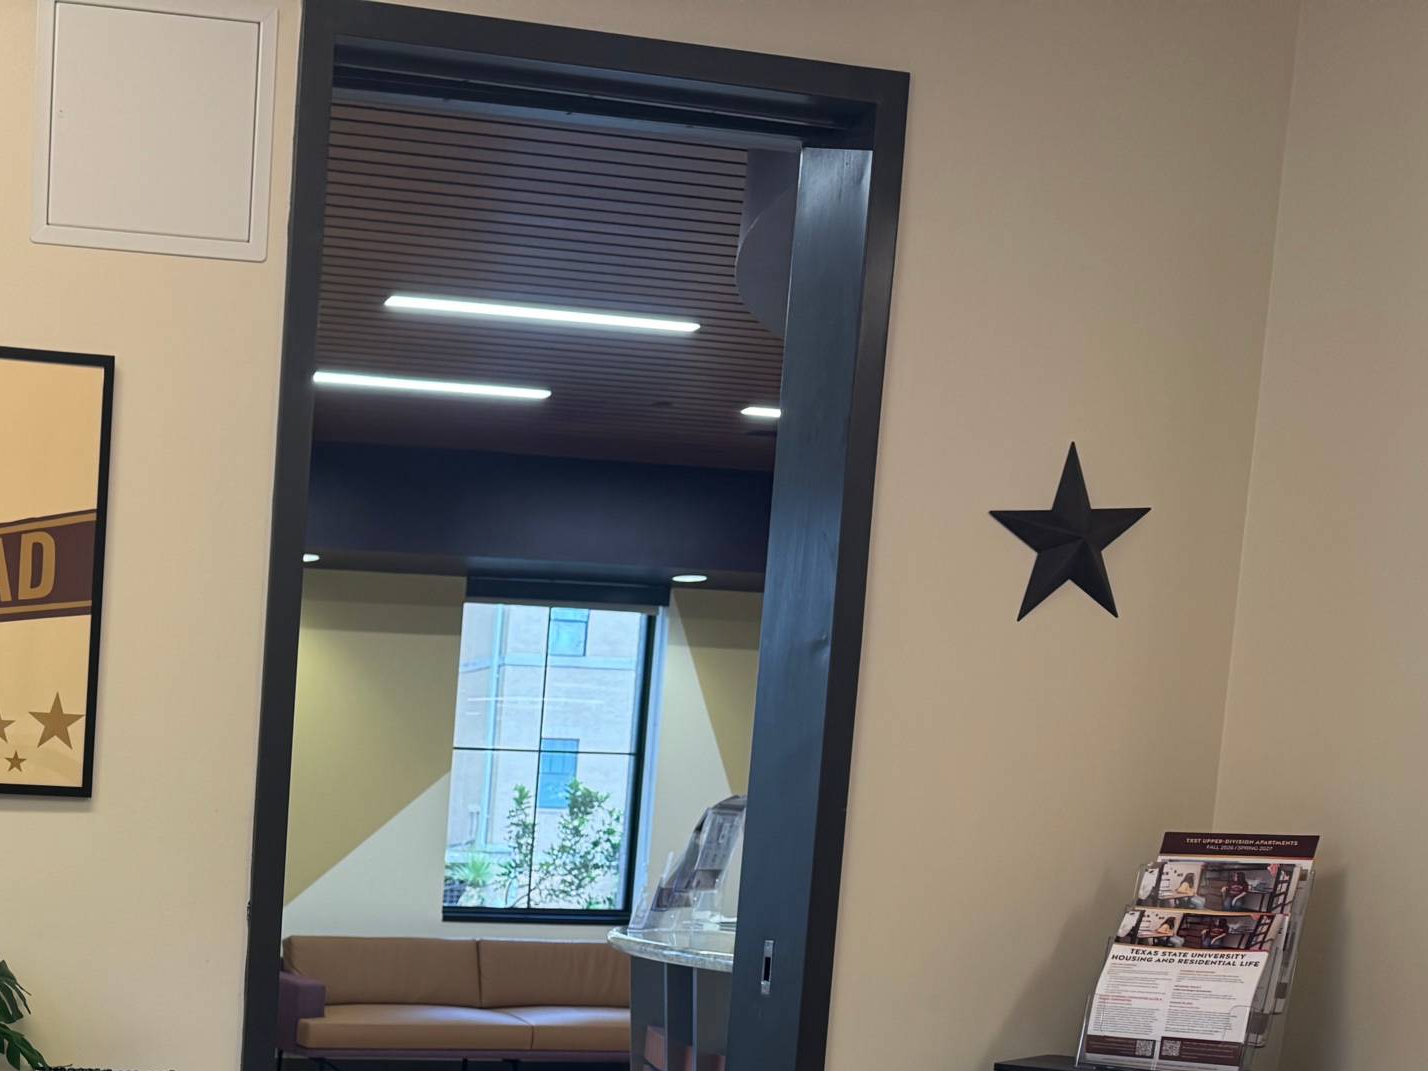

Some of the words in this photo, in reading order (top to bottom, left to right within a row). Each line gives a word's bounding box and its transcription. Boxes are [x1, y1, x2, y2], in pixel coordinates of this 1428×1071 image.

[1130, 948, 1159, 956] TEXAS
[1161, 950, 1190, 958] STATE
[1191, 952, 1246, 960] UNIVERSITY
[1111, 954, 1153, 963] HOUSING
[1177, 958, 1237, 967] RESIDENTIAL
